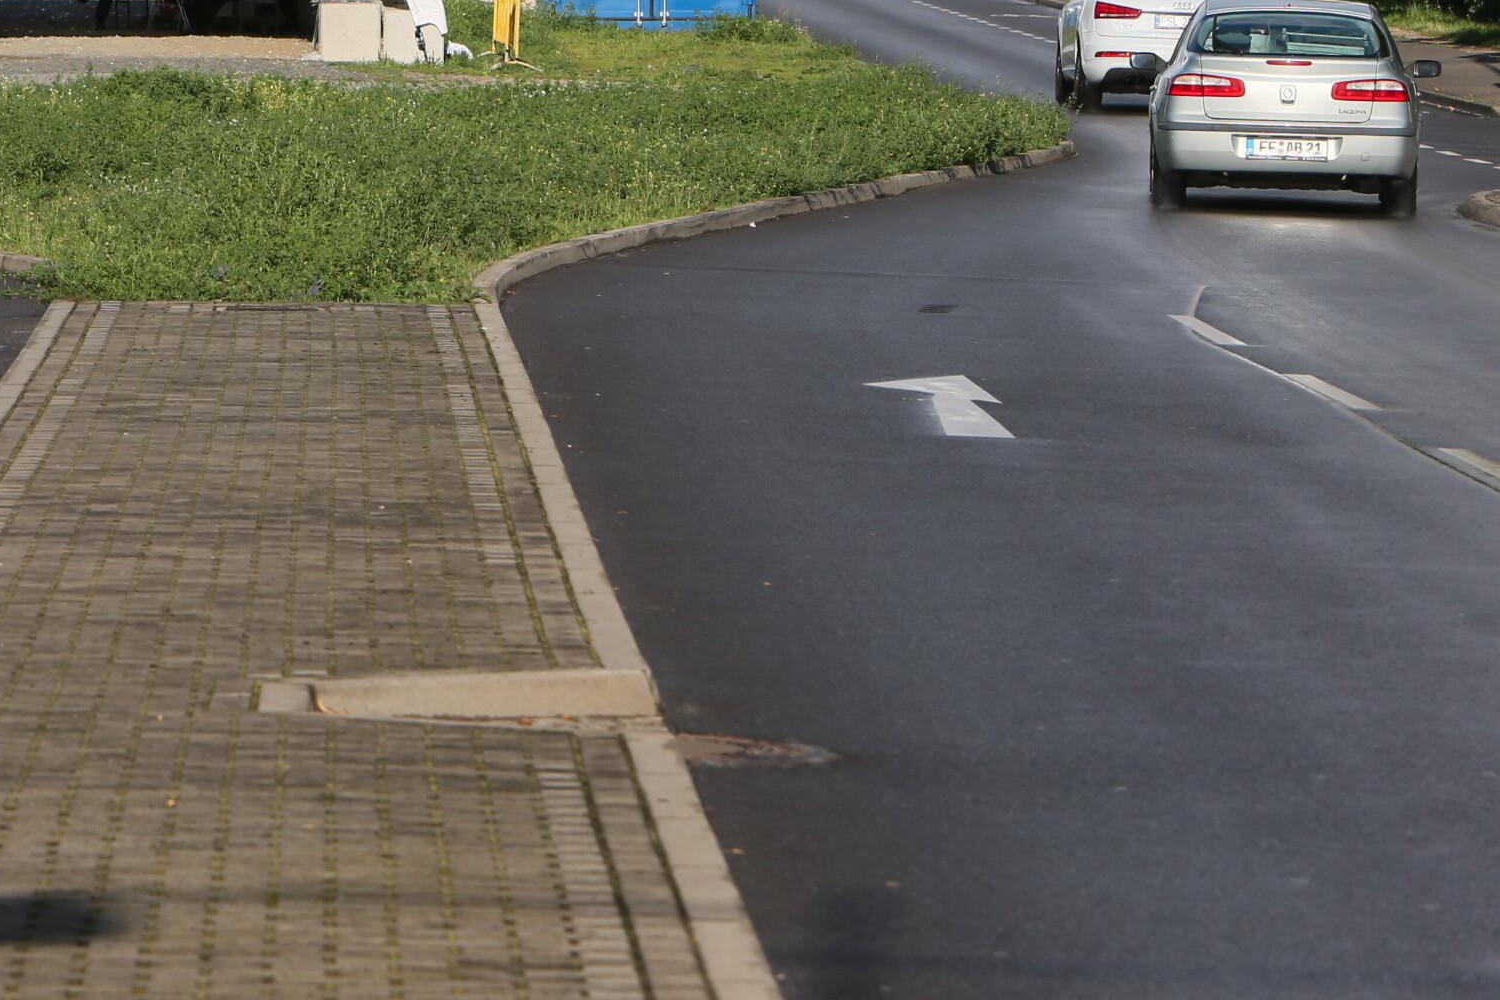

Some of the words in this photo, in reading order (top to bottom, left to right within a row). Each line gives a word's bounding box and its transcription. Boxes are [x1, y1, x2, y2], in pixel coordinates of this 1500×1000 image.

[1259, 140, 1277, 152] FF
[1286, 141, 1303, 154] AB
[1305, 142, 1321, 154] 21
